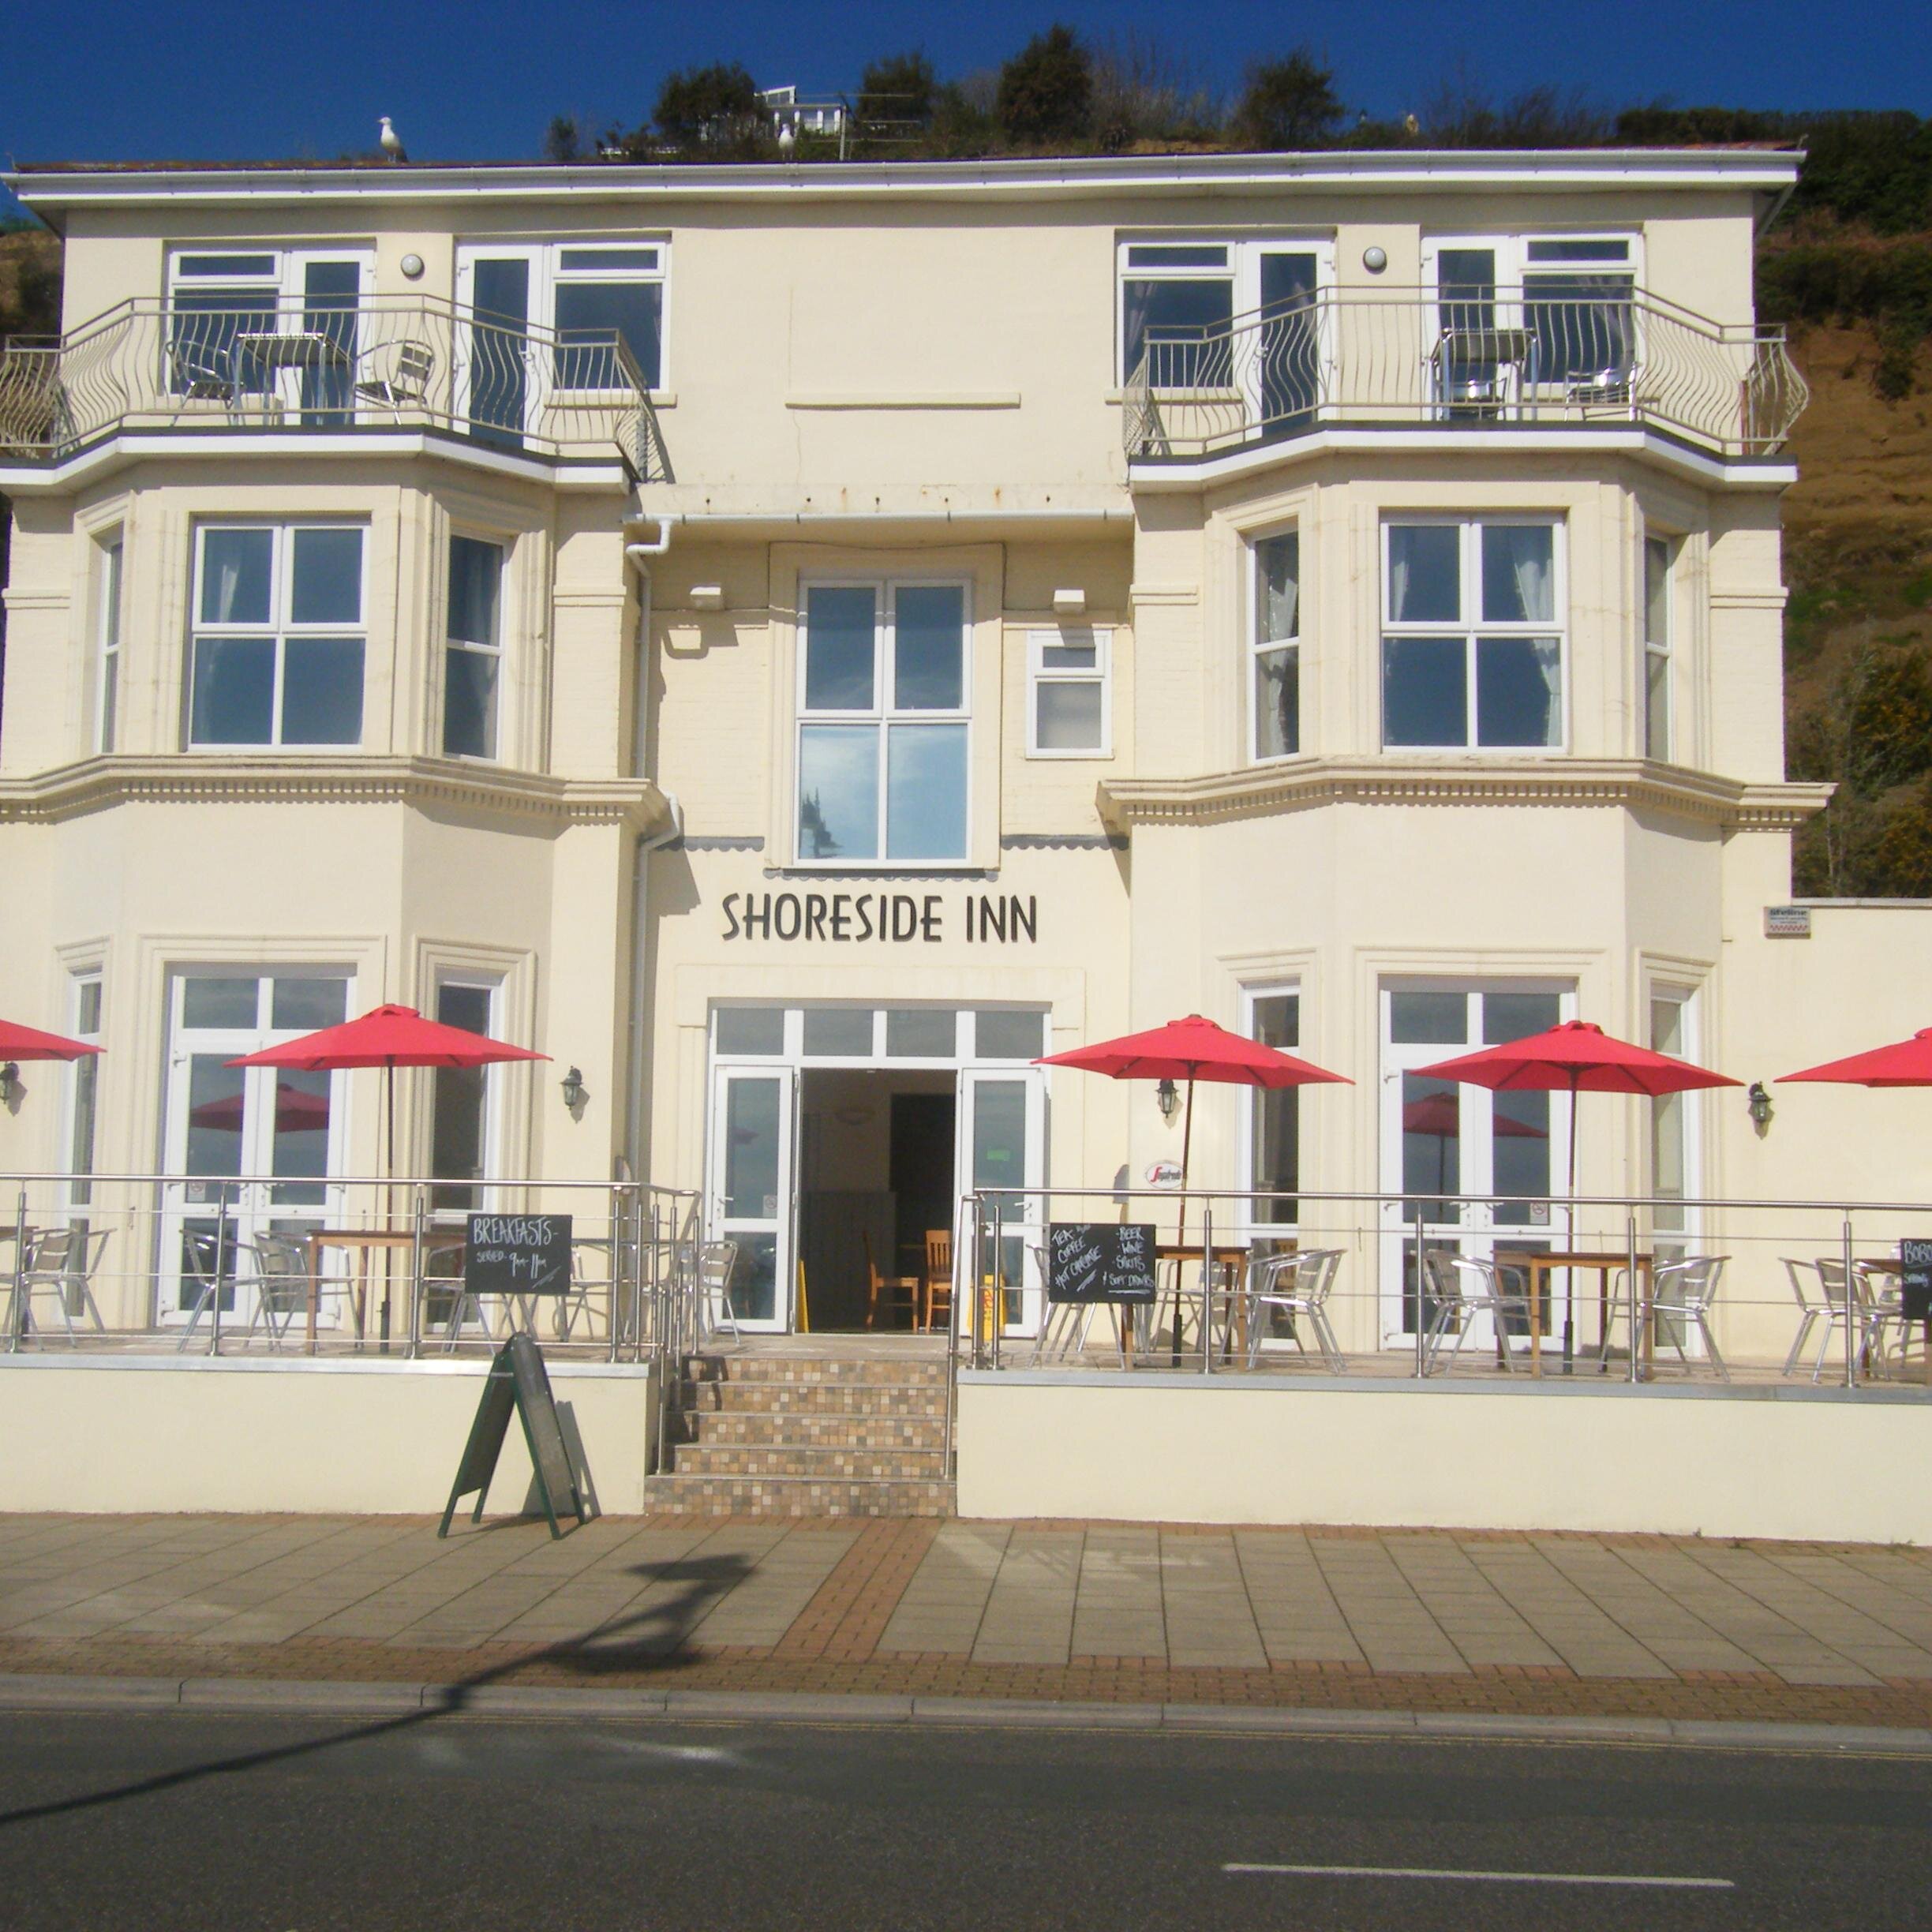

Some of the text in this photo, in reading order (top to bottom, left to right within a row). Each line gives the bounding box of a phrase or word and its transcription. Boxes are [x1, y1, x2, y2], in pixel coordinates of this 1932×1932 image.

[721, 892, 1037, 944] SHORESIDE INN
[1057, 1236, 1087, 1264] COFFEE
[1054, 1266, 1070, 1290] HOT
